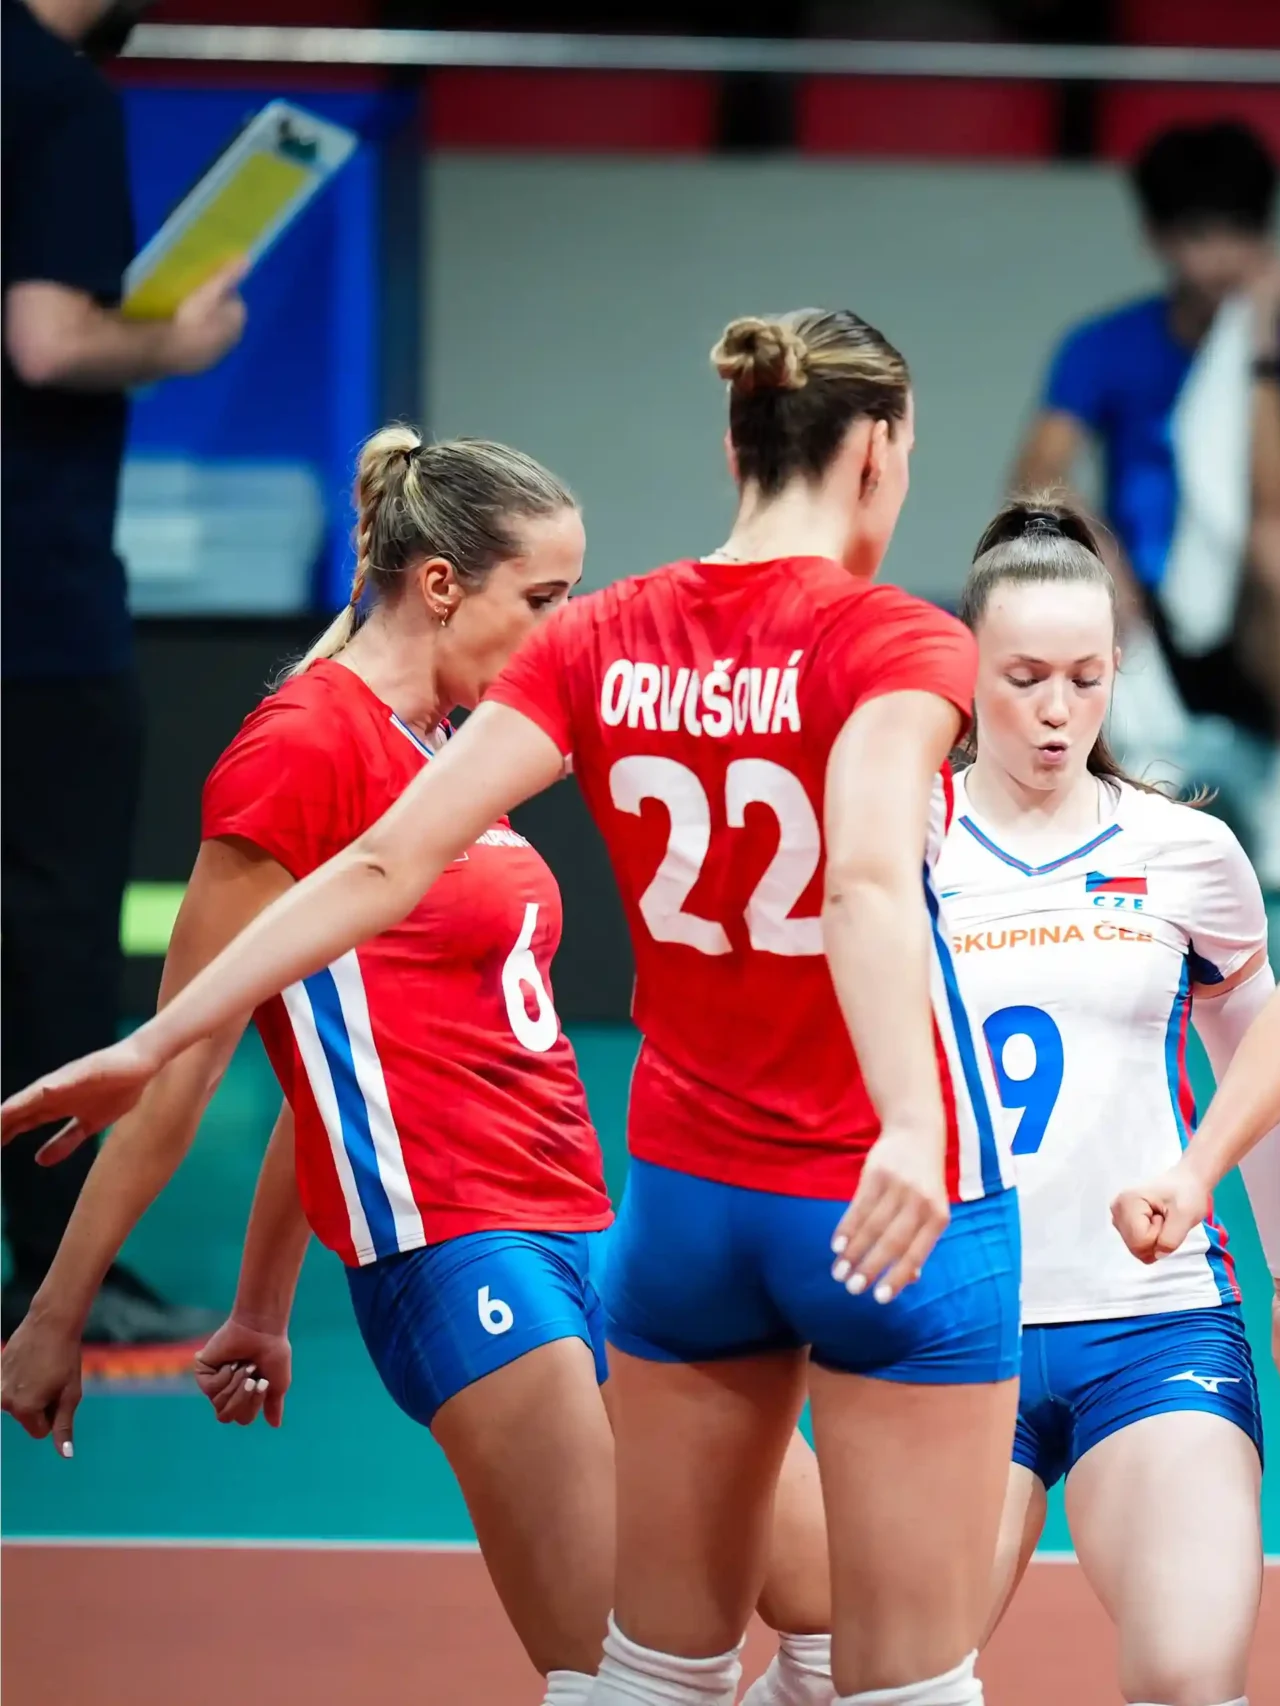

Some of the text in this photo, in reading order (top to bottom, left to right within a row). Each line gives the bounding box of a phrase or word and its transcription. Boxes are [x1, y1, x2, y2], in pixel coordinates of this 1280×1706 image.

[609, 754, 826, 957] 22
[1093, 896, 1144, 911] CZE
[502, 902, 559, 1053] 6
[982, 1005, 1065, 1156] 9
[477, 1285, 514, 1335] 6
